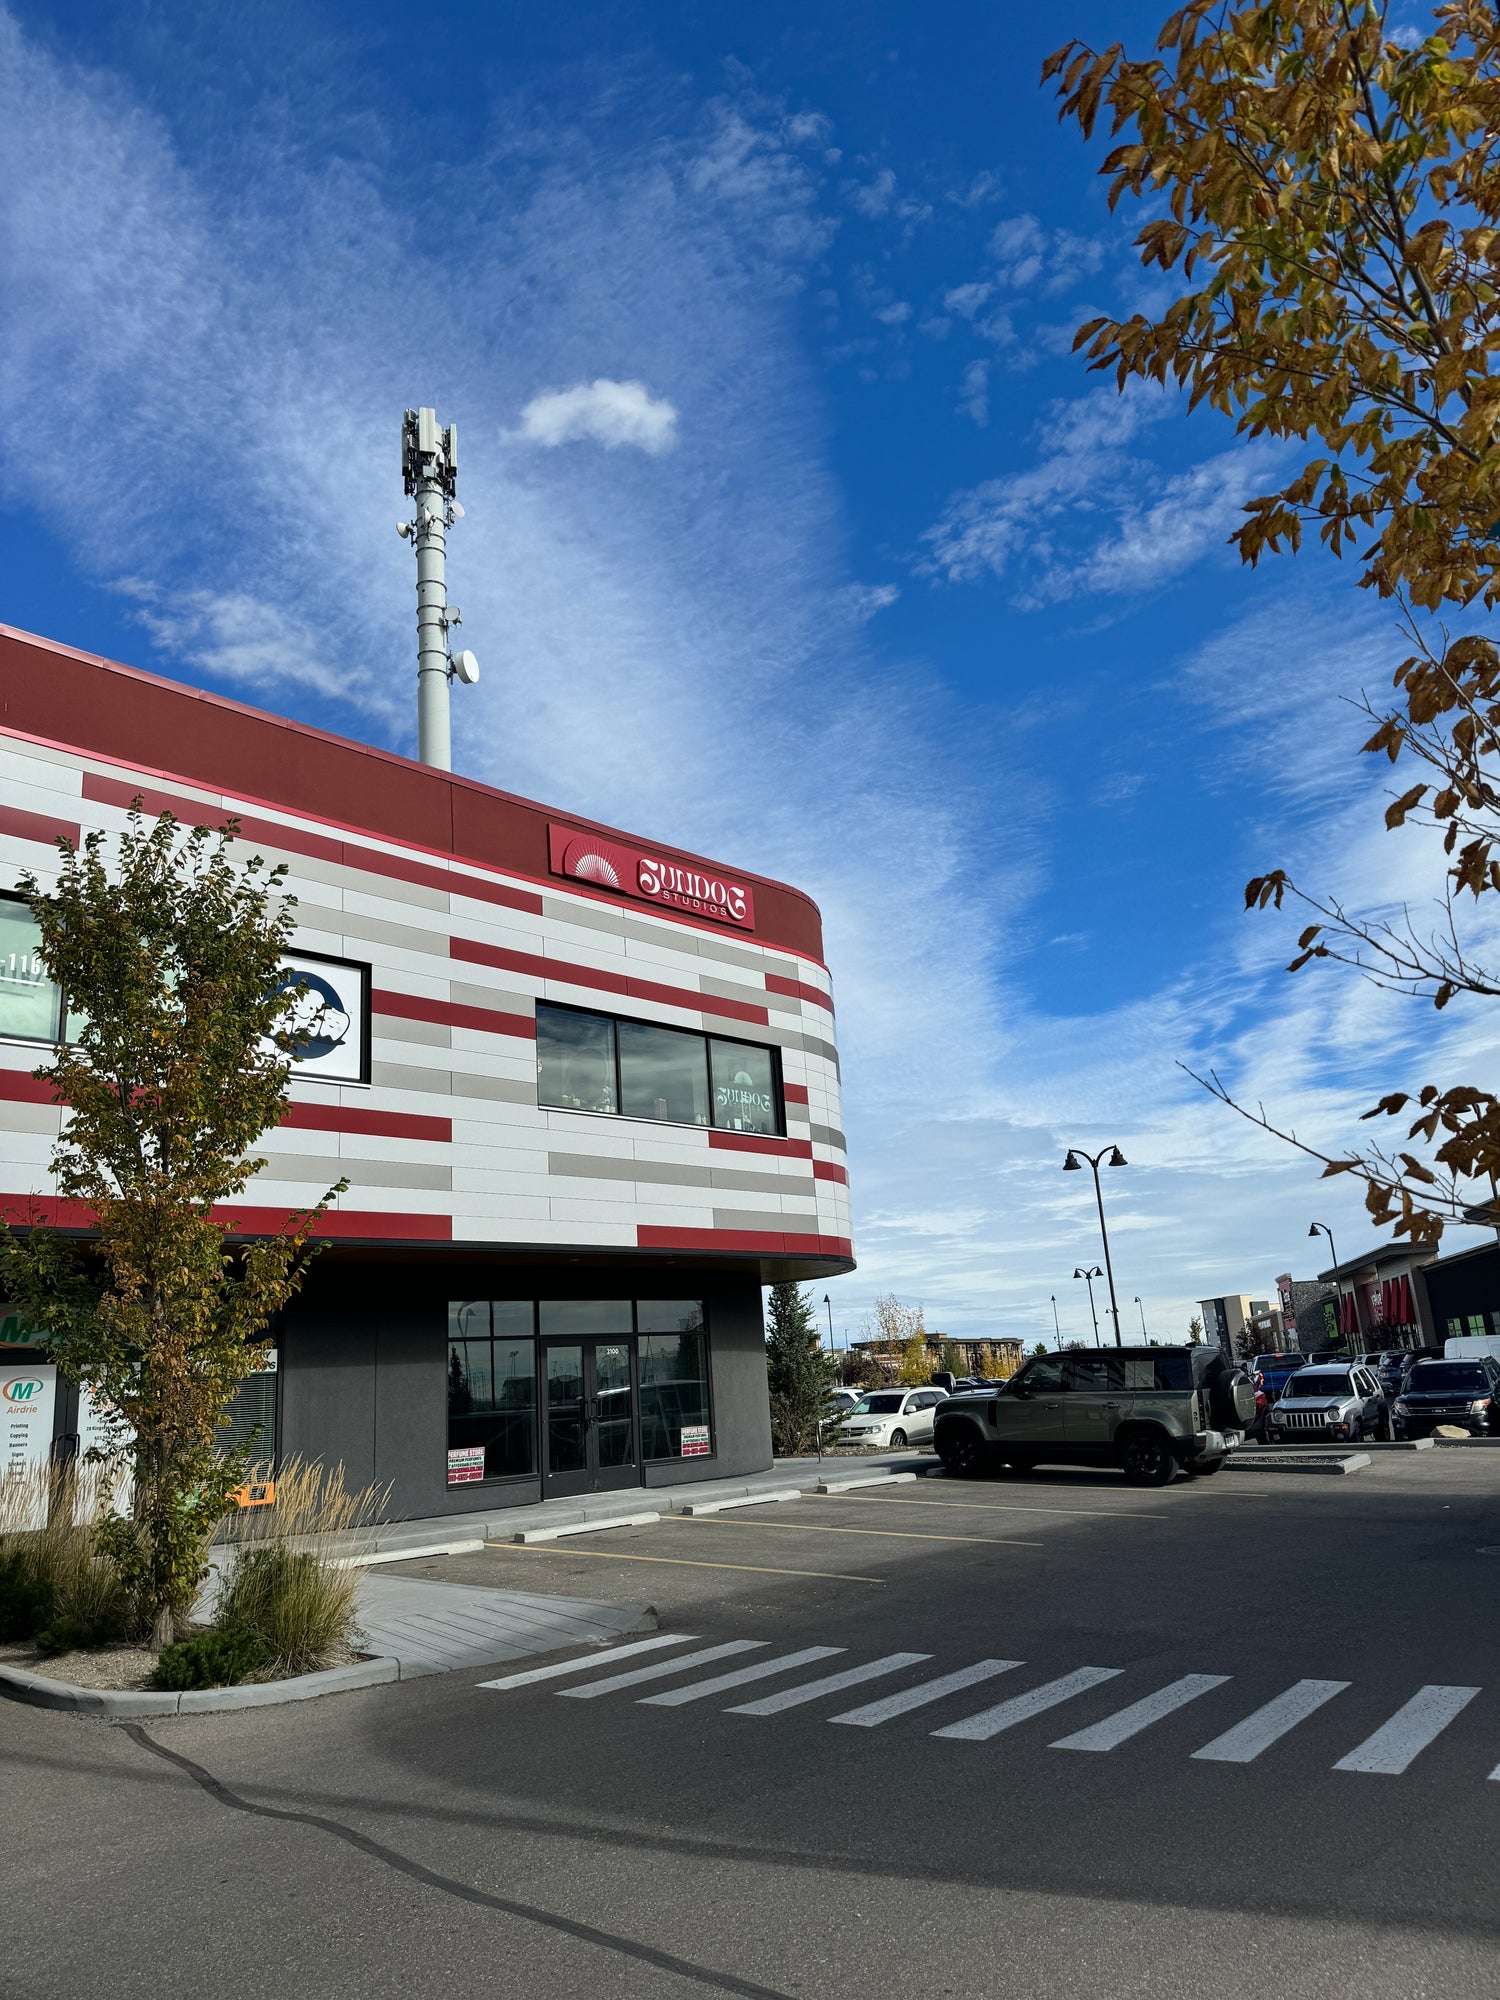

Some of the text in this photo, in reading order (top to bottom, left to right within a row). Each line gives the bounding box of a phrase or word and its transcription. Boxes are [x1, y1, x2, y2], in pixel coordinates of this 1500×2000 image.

[639, 859, 746, 920] SUNDOG
[662, 890, 727, 916] STUDIOS
[6, 1405, 38, 1414] Airdrie
[469, 1447, 485, 1456] STORE
